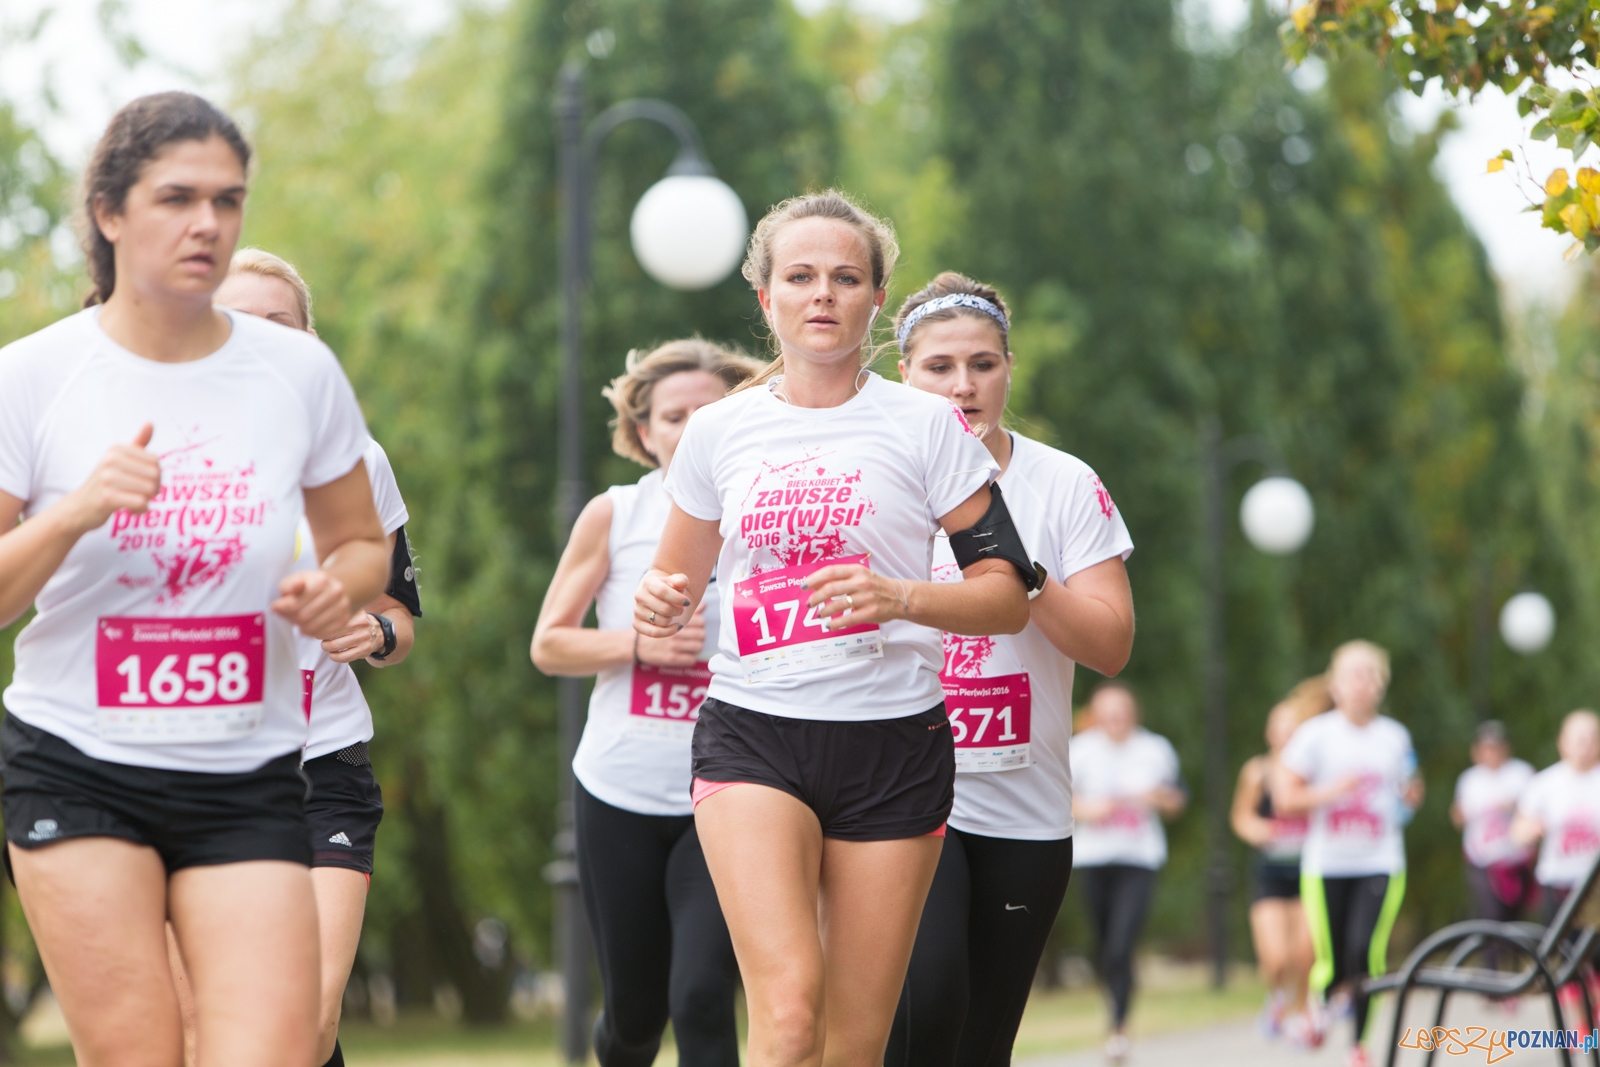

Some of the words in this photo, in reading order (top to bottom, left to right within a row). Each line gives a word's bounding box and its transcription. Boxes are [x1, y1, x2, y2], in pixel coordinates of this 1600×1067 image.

[152, 483, 248, 503] awsze
[787, 479, 807, 488] BIEG
[809, 478, 841, 487] KOBIET
[754, 487, 852, 508] zawsze
[111, 502, 265, 538] pier(w)si!
[741, 504, 865, 539] pier(w)si!
[119, 533, 166, 552] 2016
[748, 532, 780, 549] 2016
[759, 581, 787, 594] Zawsze
[116, 652, 249, 704] 1658
[645, 681, 708, 719] 152
[959, 686, 991, 697] Pier(w)si
[992, 686, 1010, 695] 2016
[948, 705, 1017, 743] 671
